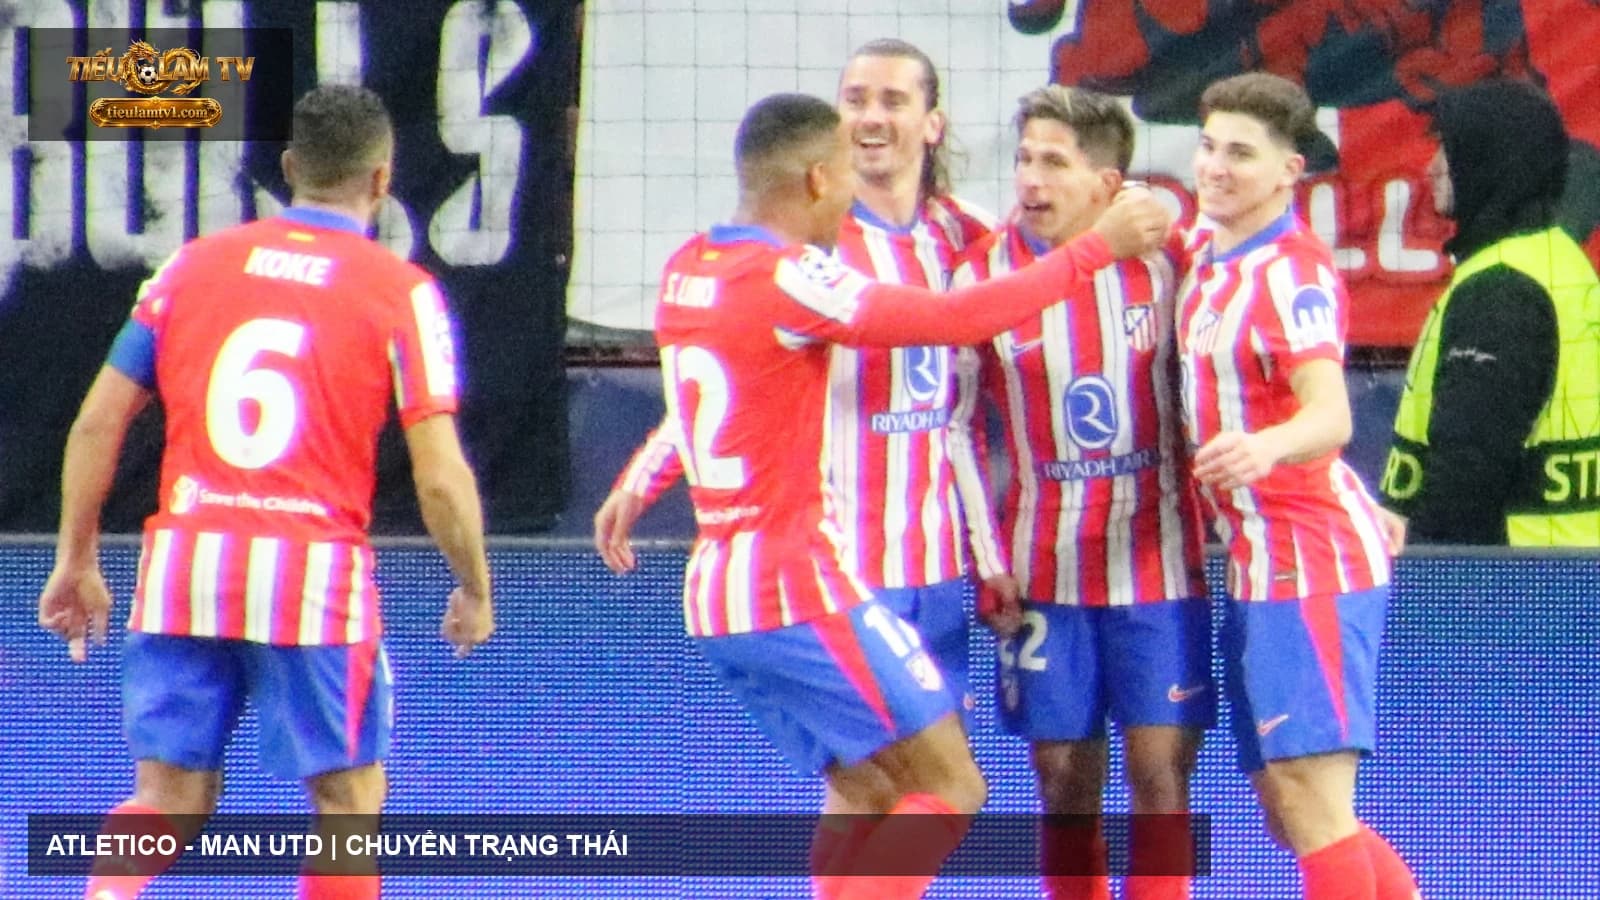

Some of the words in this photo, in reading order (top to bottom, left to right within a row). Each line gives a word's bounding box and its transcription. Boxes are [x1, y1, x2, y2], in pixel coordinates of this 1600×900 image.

[244, 247, 332, 286] KOKE
[206, 318, 305, 470] 6
[871, 410, 935, 432] RIYADH
[1043, 458, 1117, 480] RIYADH
[1121, 448, 1152, 473] AIR
